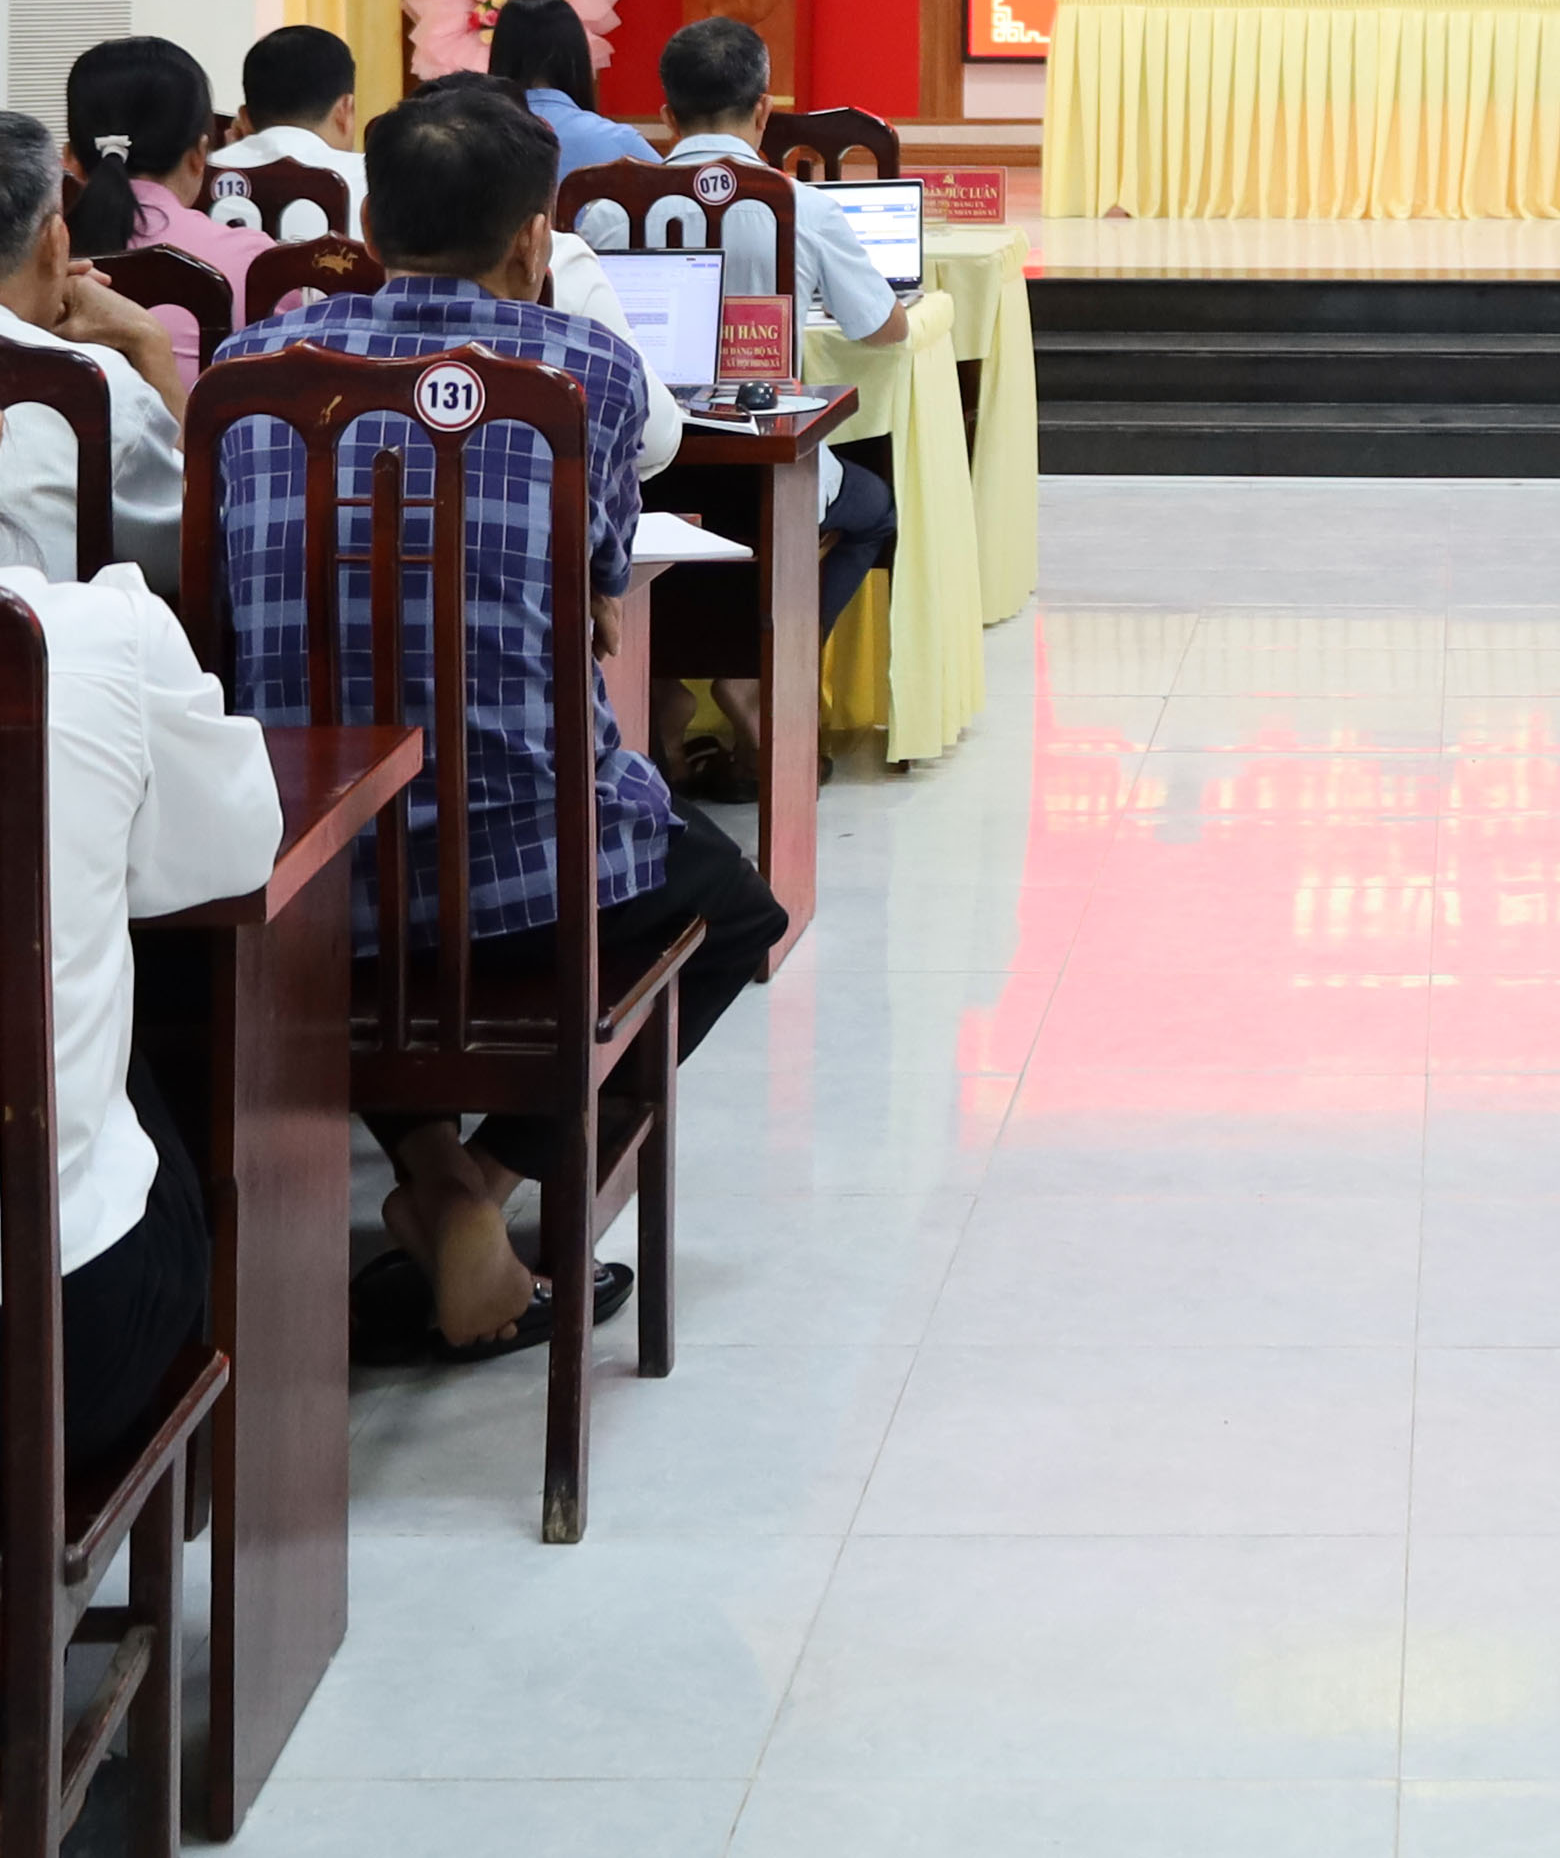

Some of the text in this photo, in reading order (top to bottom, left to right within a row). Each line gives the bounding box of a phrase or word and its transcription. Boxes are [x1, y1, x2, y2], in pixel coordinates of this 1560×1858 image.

[218, 181, 244, 196] 113
[700, 175, 730, 193] 078
[428, 382, 472, 410] 131
